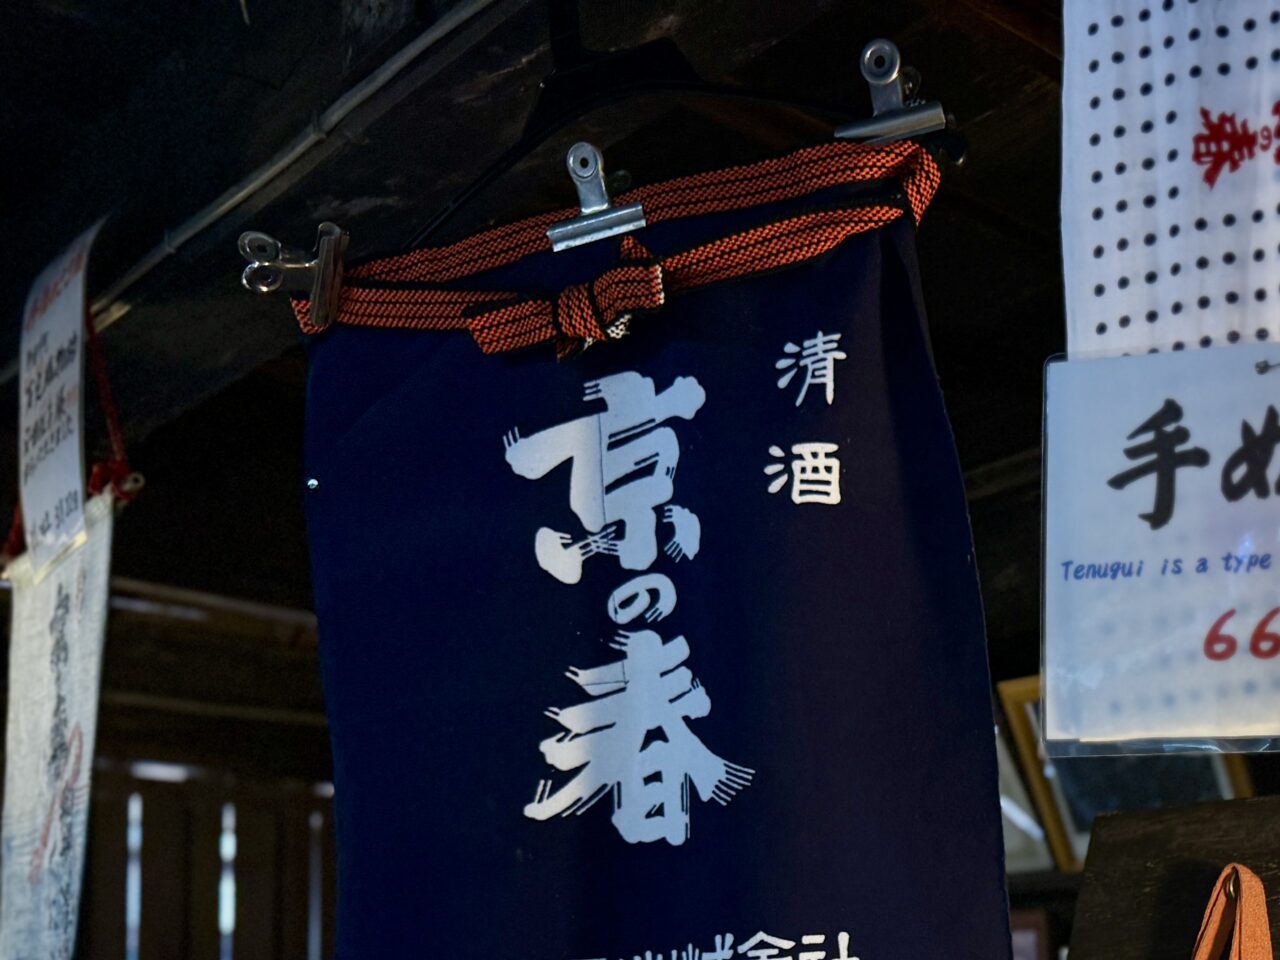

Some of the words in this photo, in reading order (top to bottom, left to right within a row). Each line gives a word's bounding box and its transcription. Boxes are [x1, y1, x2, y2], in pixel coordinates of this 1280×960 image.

[764, 330, 846, 504] 清酒
[503, 370, 756, 846] 京の春
[1061, 559, 1144, 581] Tenugui
[1161, 556, 1183, 576] is
[1196, 556, 1209, 573] a
[1221, 550, 1272, 573] type
